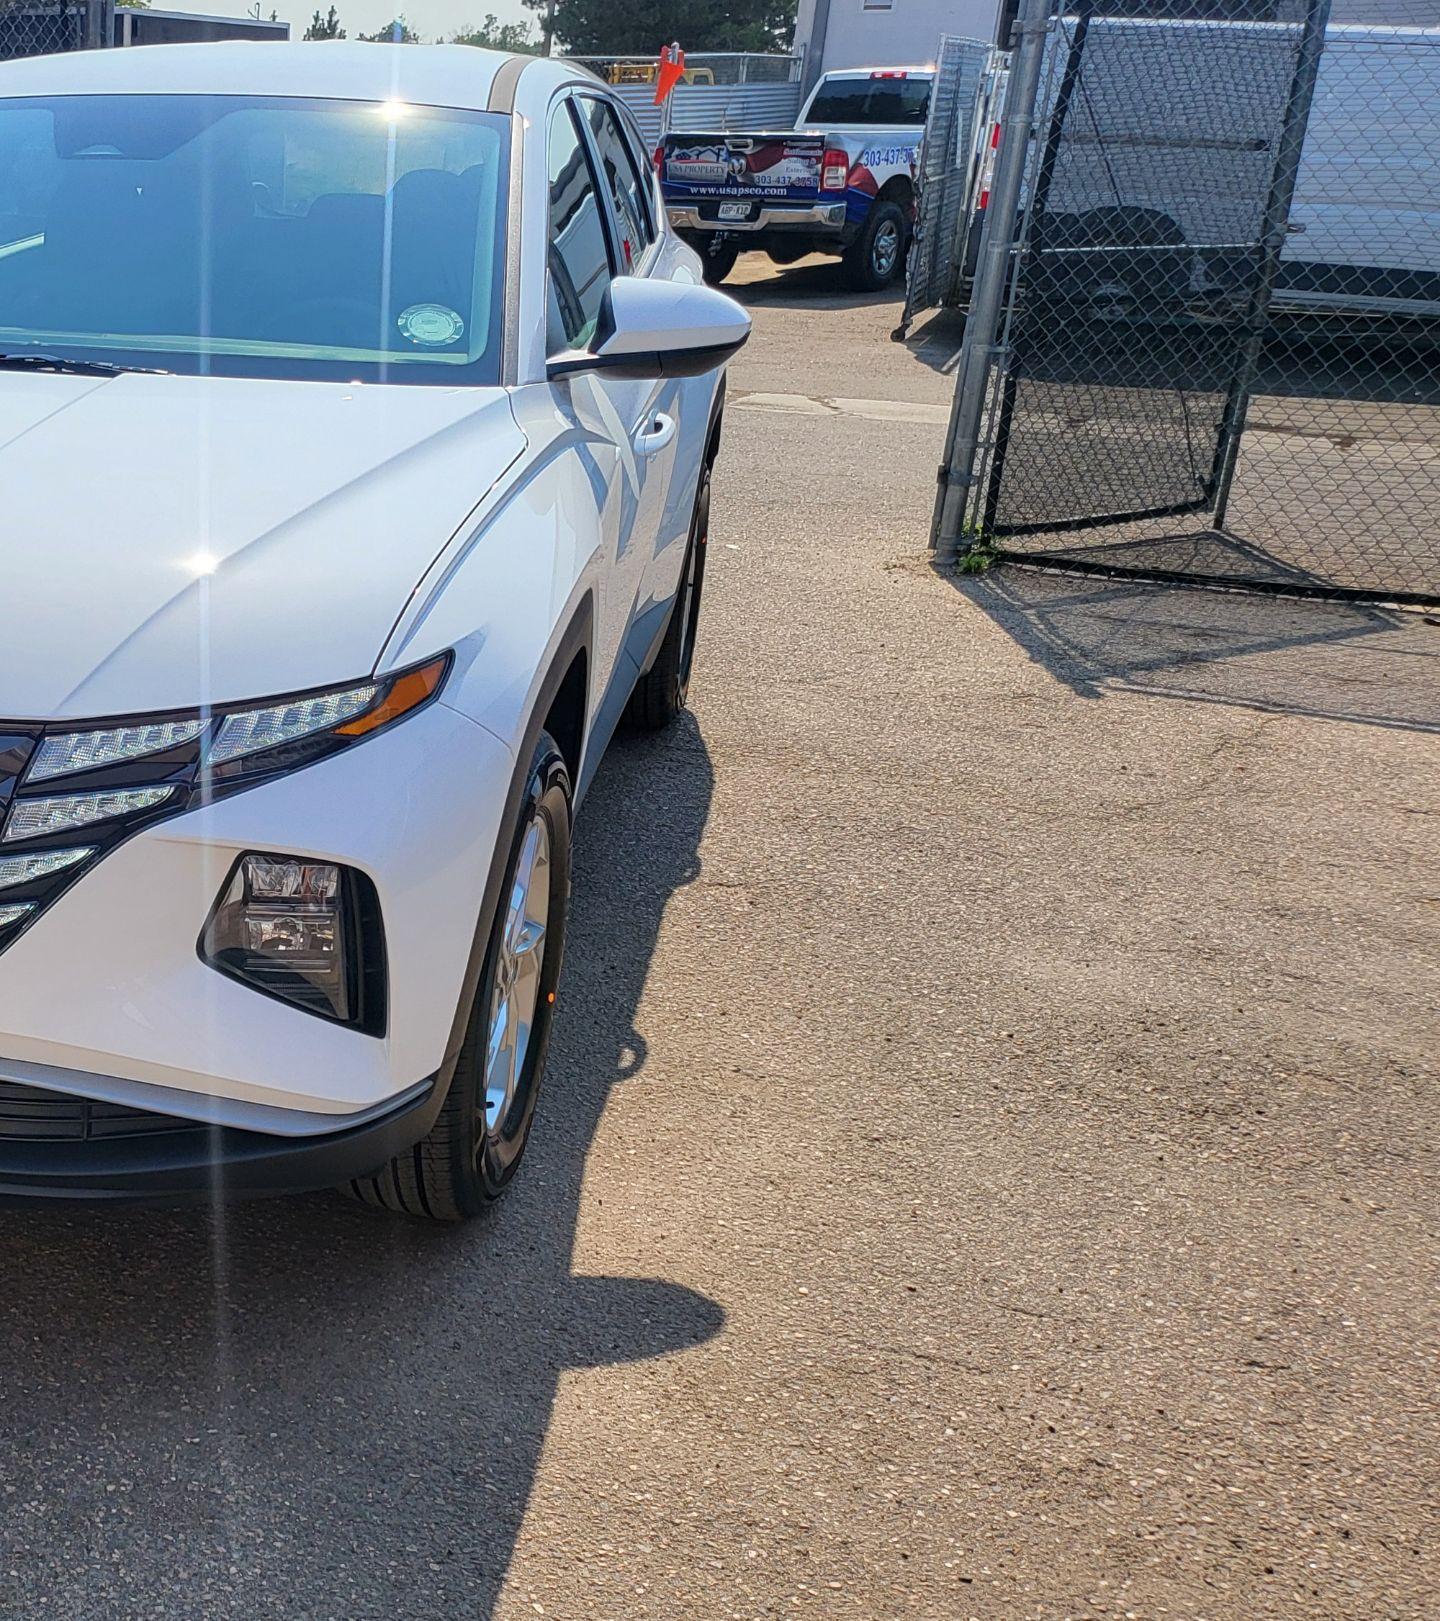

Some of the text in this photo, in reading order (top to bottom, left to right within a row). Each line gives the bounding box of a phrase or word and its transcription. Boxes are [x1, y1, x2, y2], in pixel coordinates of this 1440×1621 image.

[684, 165, 725, 175] PROPERTY
[755, 175, 818, 187] 303-437-3758
[689, 186, 788, 197] www.usapsco.com
